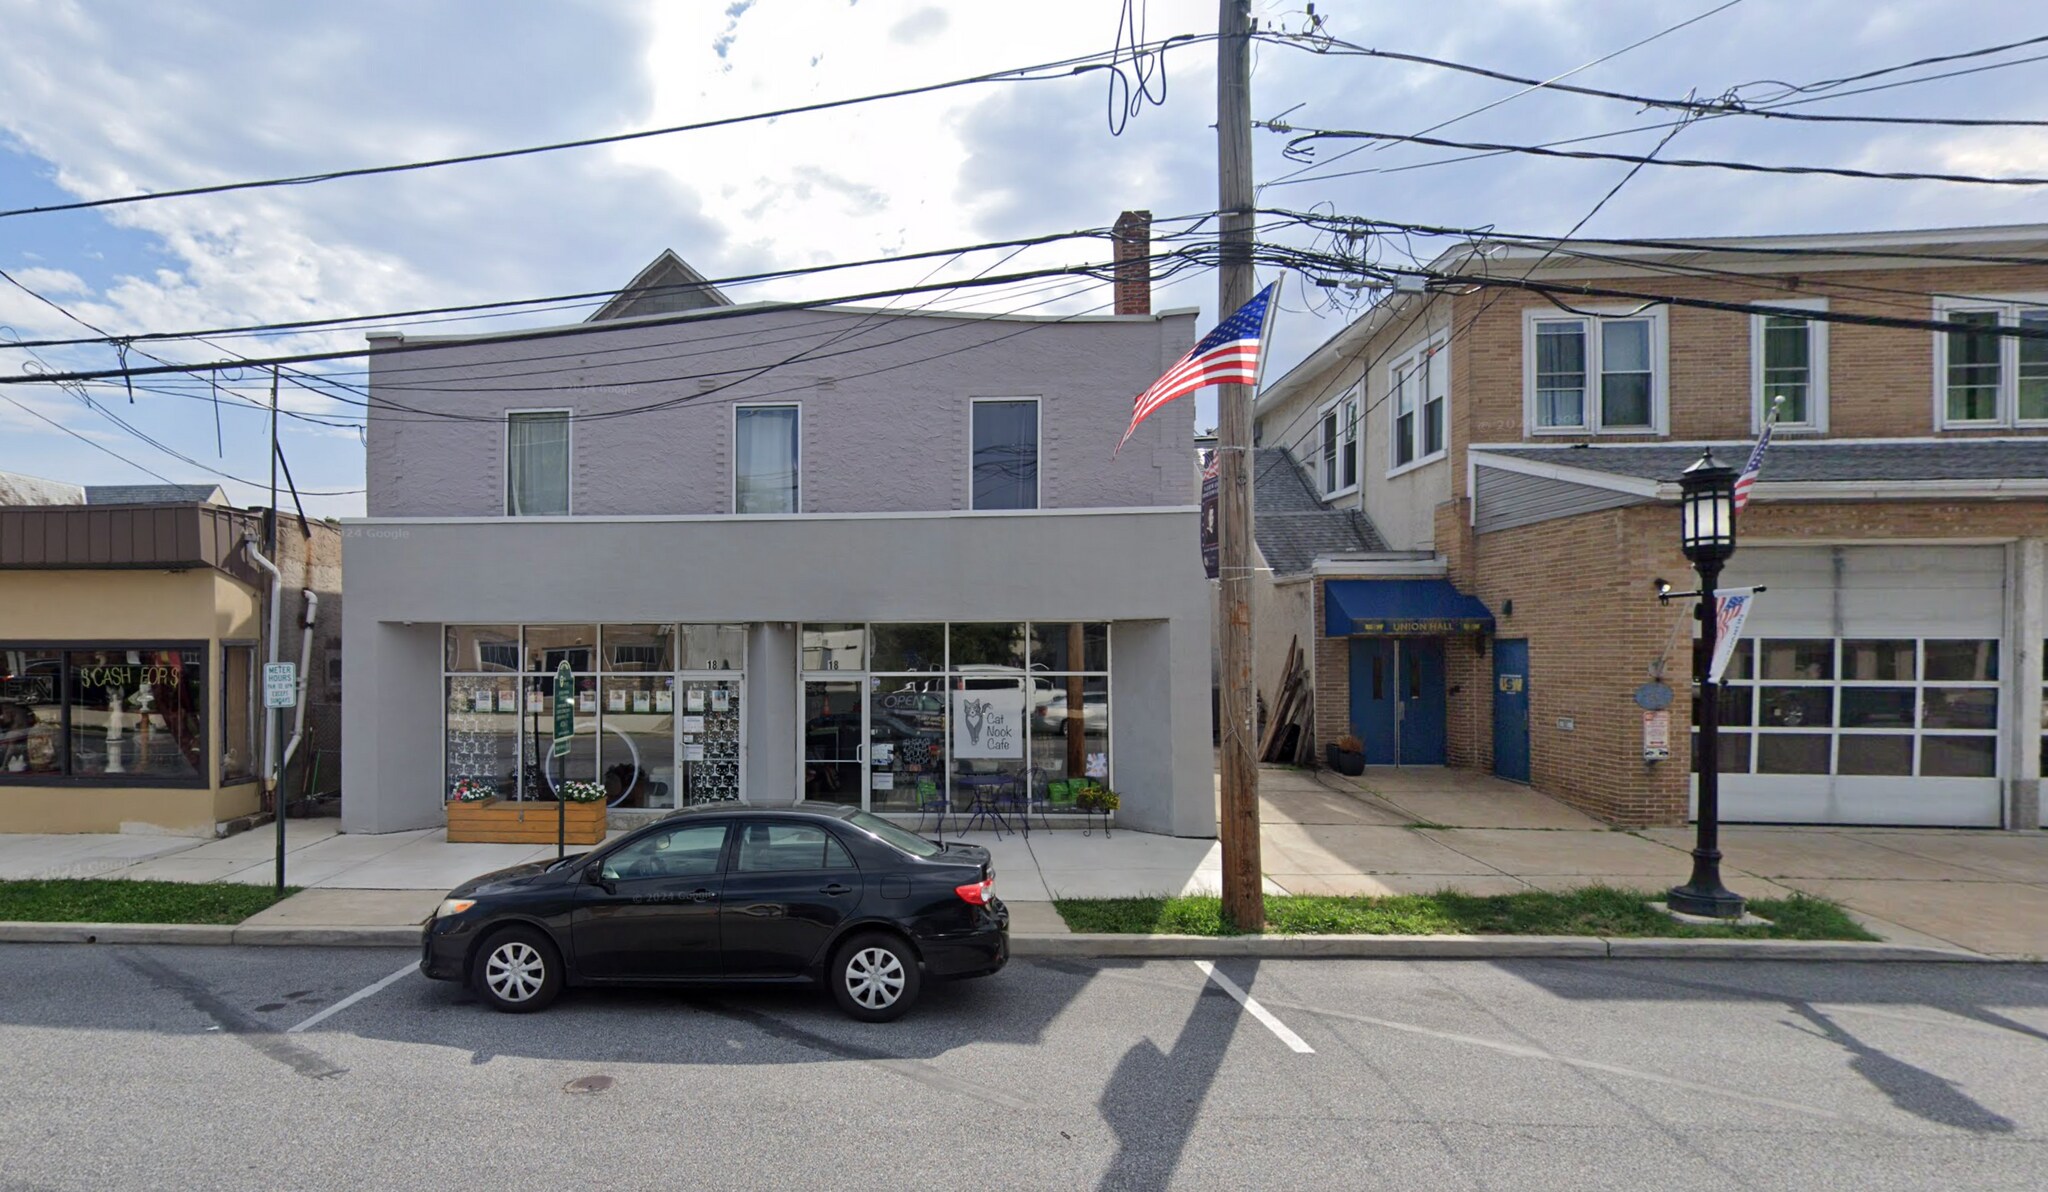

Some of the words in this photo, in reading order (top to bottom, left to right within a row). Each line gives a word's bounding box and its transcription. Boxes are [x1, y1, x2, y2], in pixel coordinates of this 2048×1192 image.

[1393, 622, 1427, 631] UNION
[1429, 622, 1453, 631] HALL
[707, 660, 718, 670] 18
[828, 660, 839, 670] 18
[92, 667, 131, 687] CASH
[884, 695, 924, 708] OPEN
[986, 712, 1004, 725] Cat
[986, 725, 1013, 738] Nook
[986, 738, 1010, 750] Cafe
